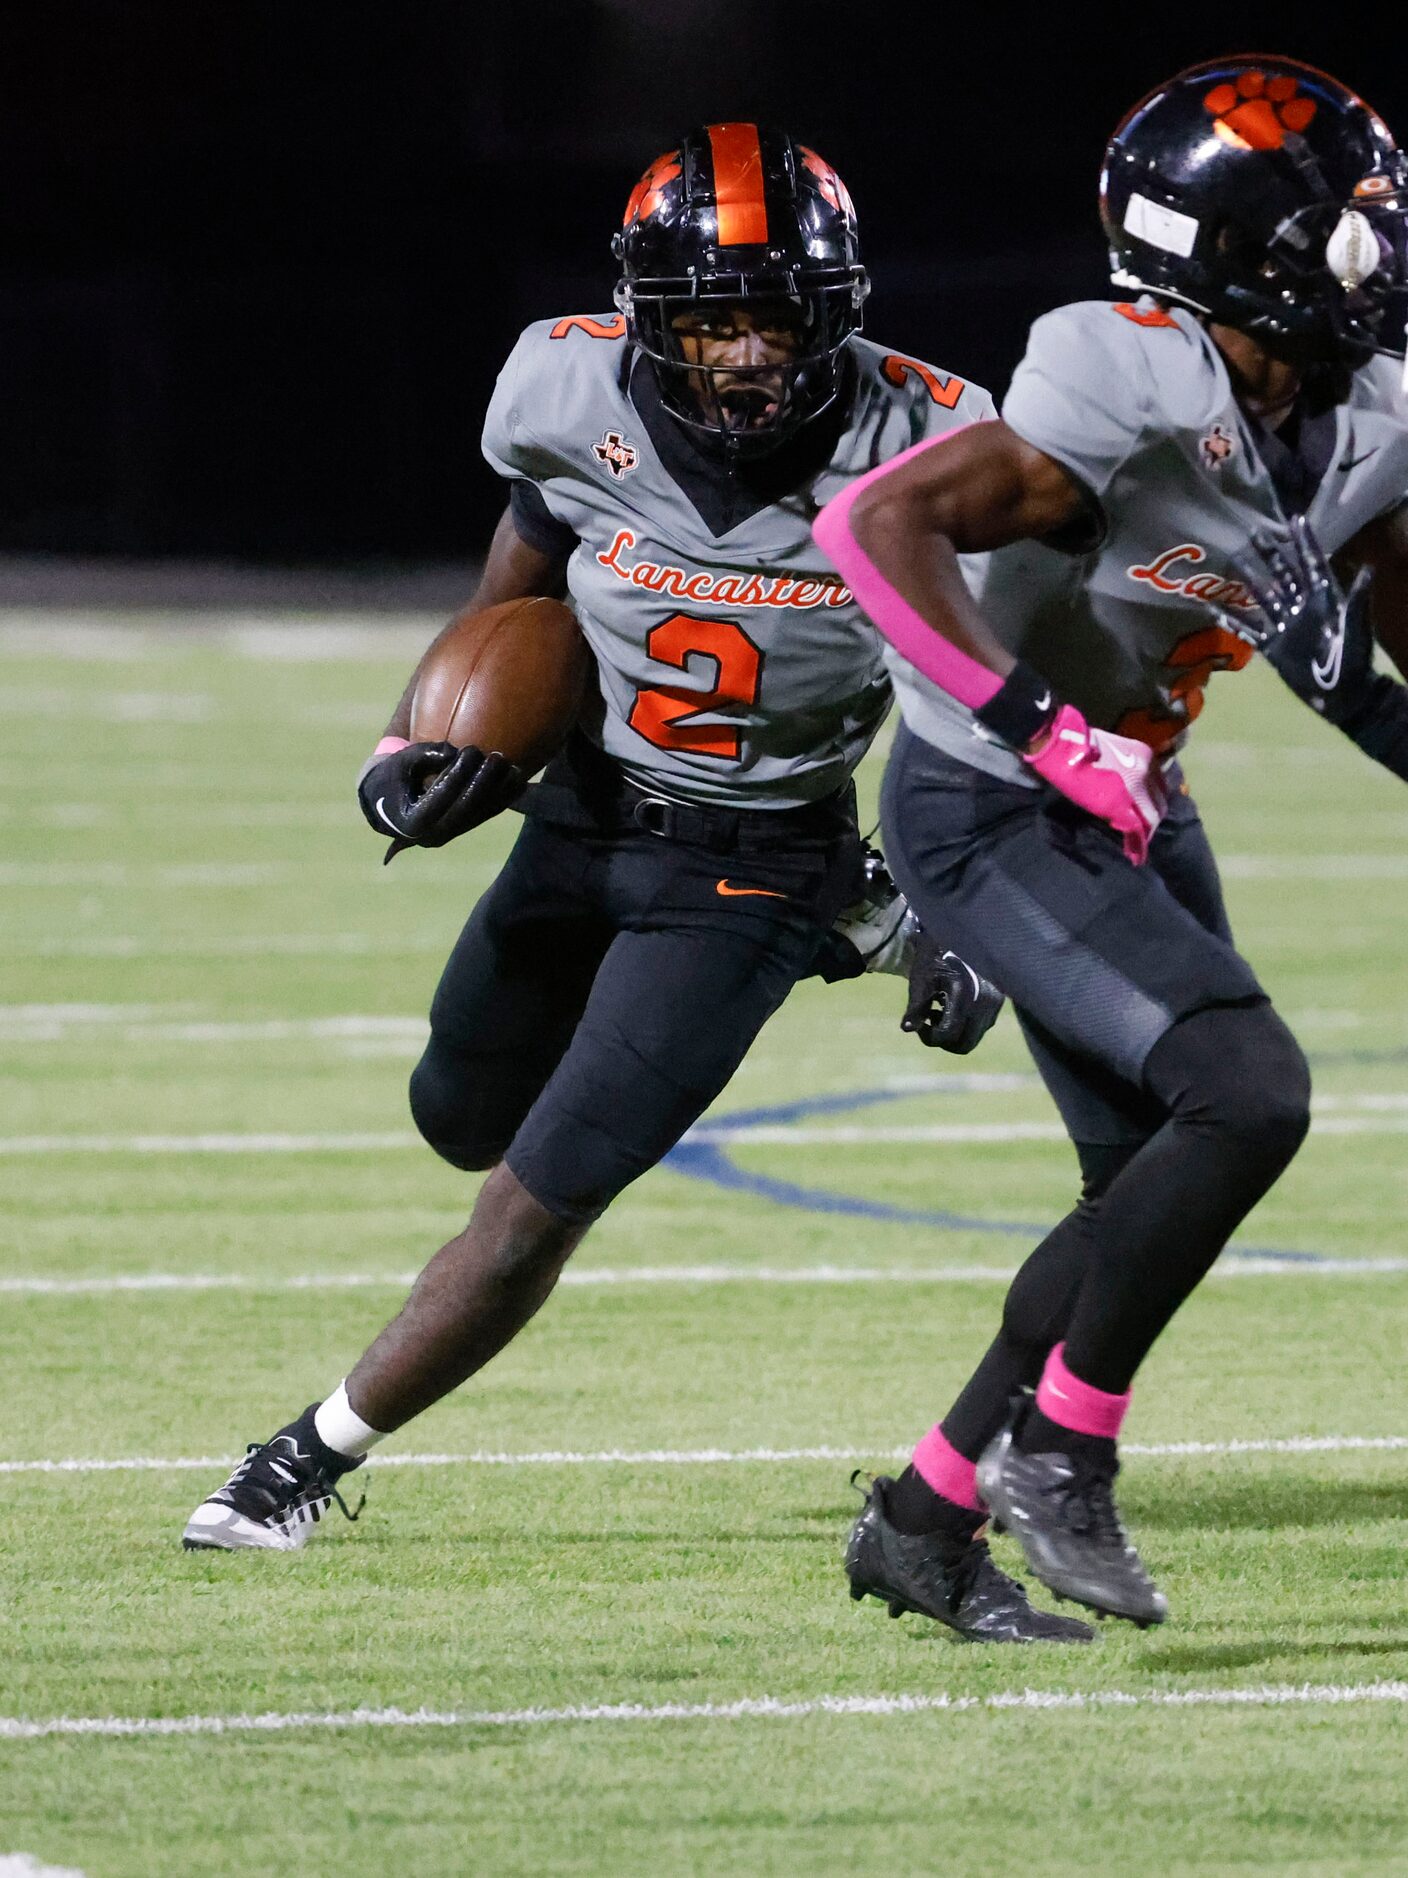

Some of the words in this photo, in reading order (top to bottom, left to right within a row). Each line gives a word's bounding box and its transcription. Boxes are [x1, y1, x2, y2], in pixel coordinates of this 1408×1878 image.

[879, 355, 966, 410] 2
[596, 528, 854, 609] Lancaster
[626, 611, 767, 763] 2
